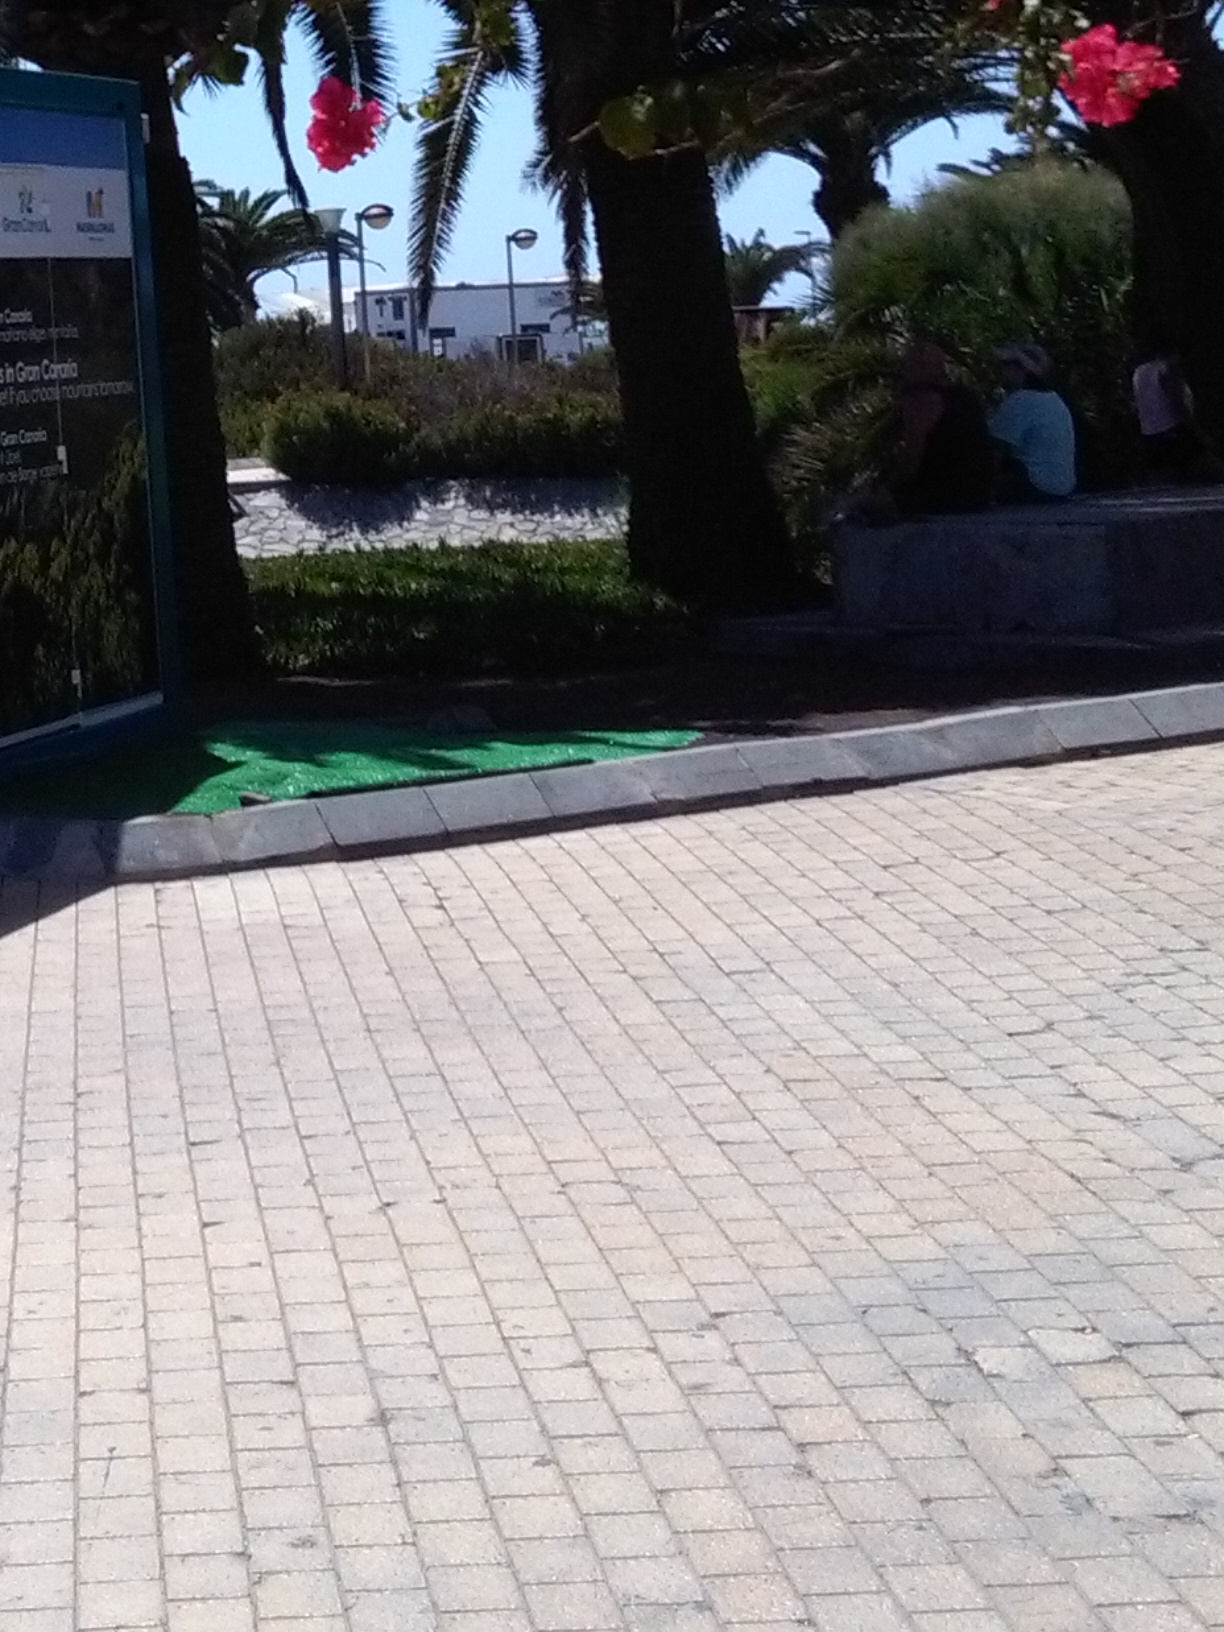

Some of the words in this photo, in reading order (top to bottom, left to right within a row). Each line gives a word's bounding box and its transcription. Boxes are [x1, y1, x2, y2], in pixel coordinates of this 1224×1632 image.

[4, 307, 33, 324] Canaria
[4, 362, 15, 384] in
[16, 360, 40, 383] Gran
[41, 358, 78, 380] Canaria
[17, 388, 31, 409] you
[0, 430, 18, 447] Gran
[19, 426, 47, 444] Canaria
